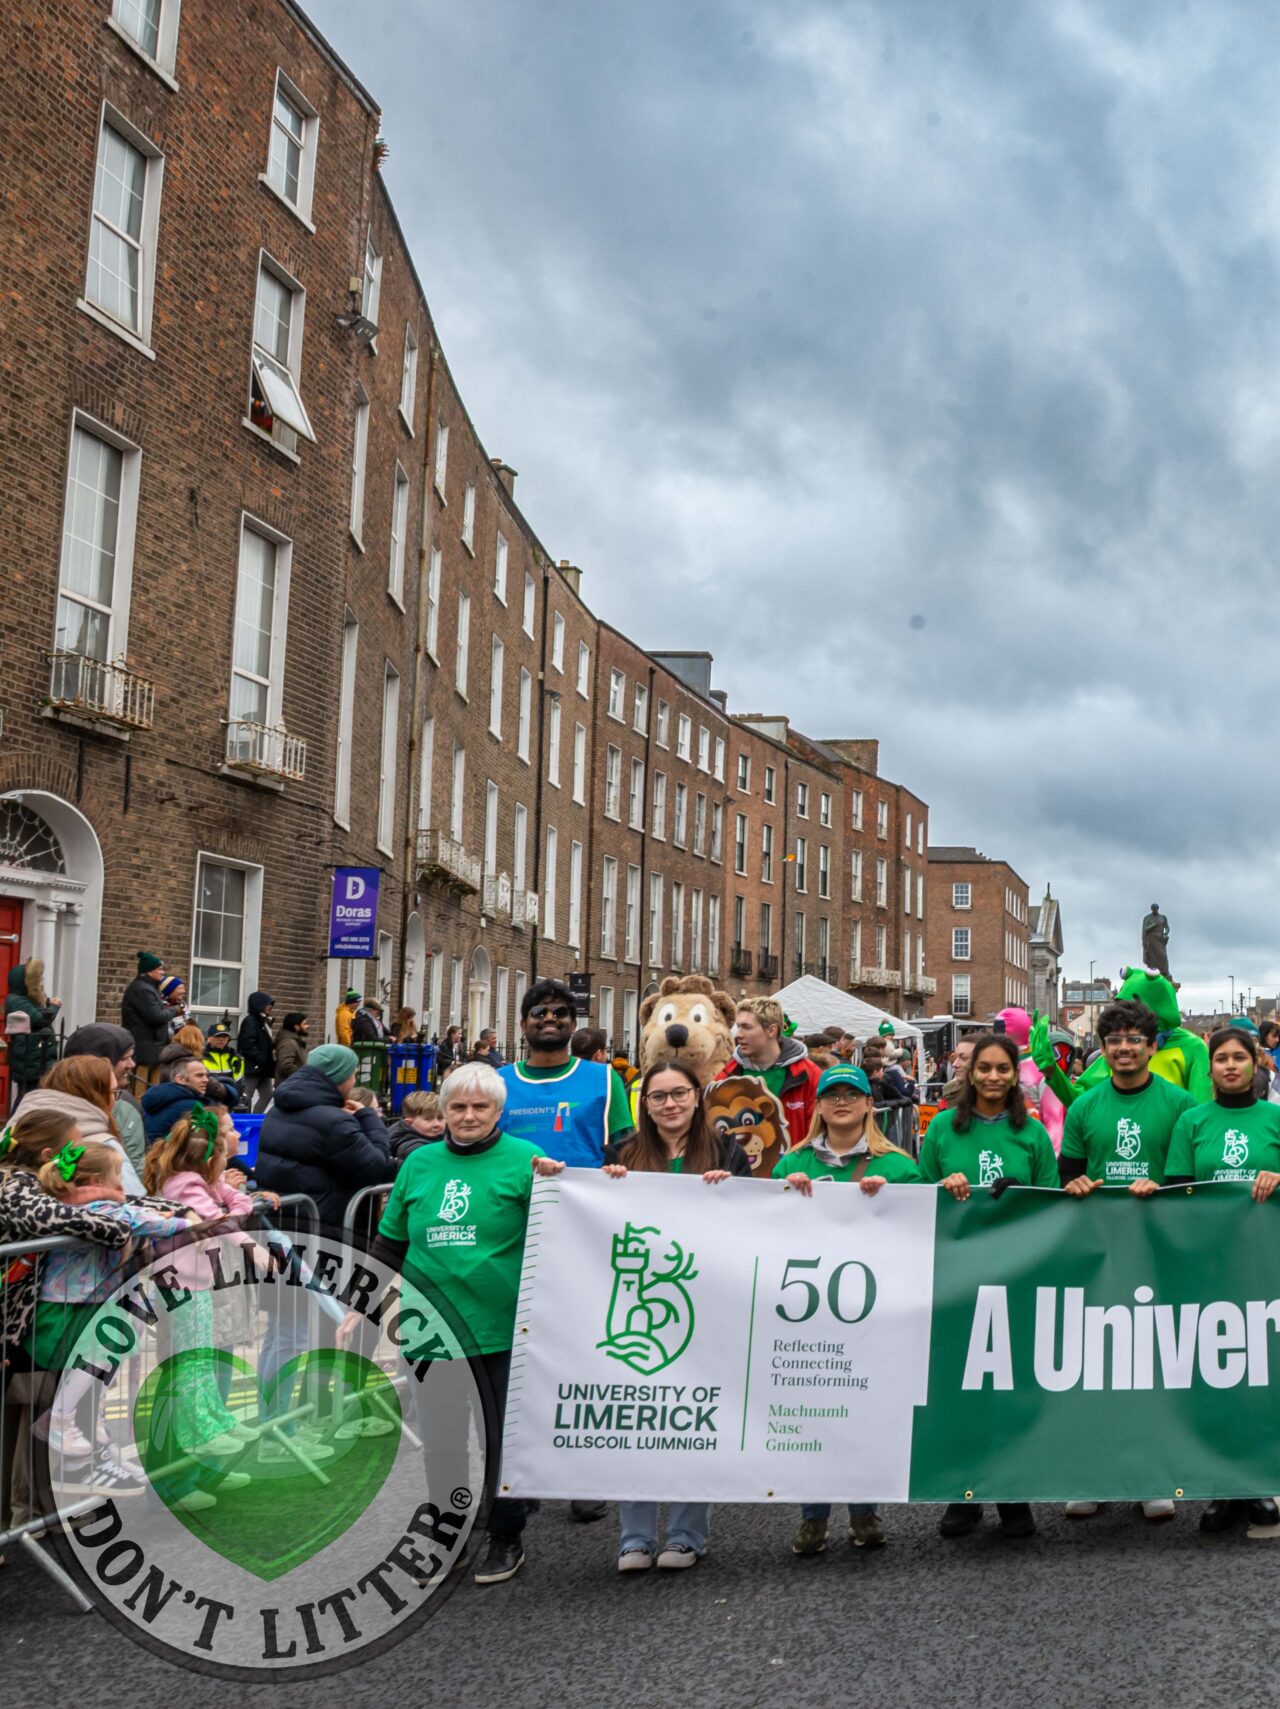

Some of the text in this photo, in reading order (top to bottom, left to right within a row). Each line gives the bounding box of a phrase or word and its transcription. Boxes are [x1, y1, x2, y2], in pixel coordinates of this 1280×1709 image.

[336, 905, 372, 918] Doras
[1105, 1167, 1149, 1176] LIMERICK
[426, 1225, 465, 1233] UNIVERSITY
[426, 1231, 477, 1243] LIMERICK
[775, 1256, 877, 1324] 50
[961, 1285, 1014, 1391] A
[773, 1339, 845, 1356] Reflecting
[772, 1356, 853, 1373] Connecting
[771, 1373, 870, 1391] Transforming
[558, 1383, 721, 1403] UNIVERSITY OF
[554, 1403, 719, 1432] LIMERICK
[768, 1403, 849, 1418] Machnamh
[767, 1421, 803, 1435] Nasc
[553, 1435, 718, 1451] OLLSCOIL LUIMNIGH
